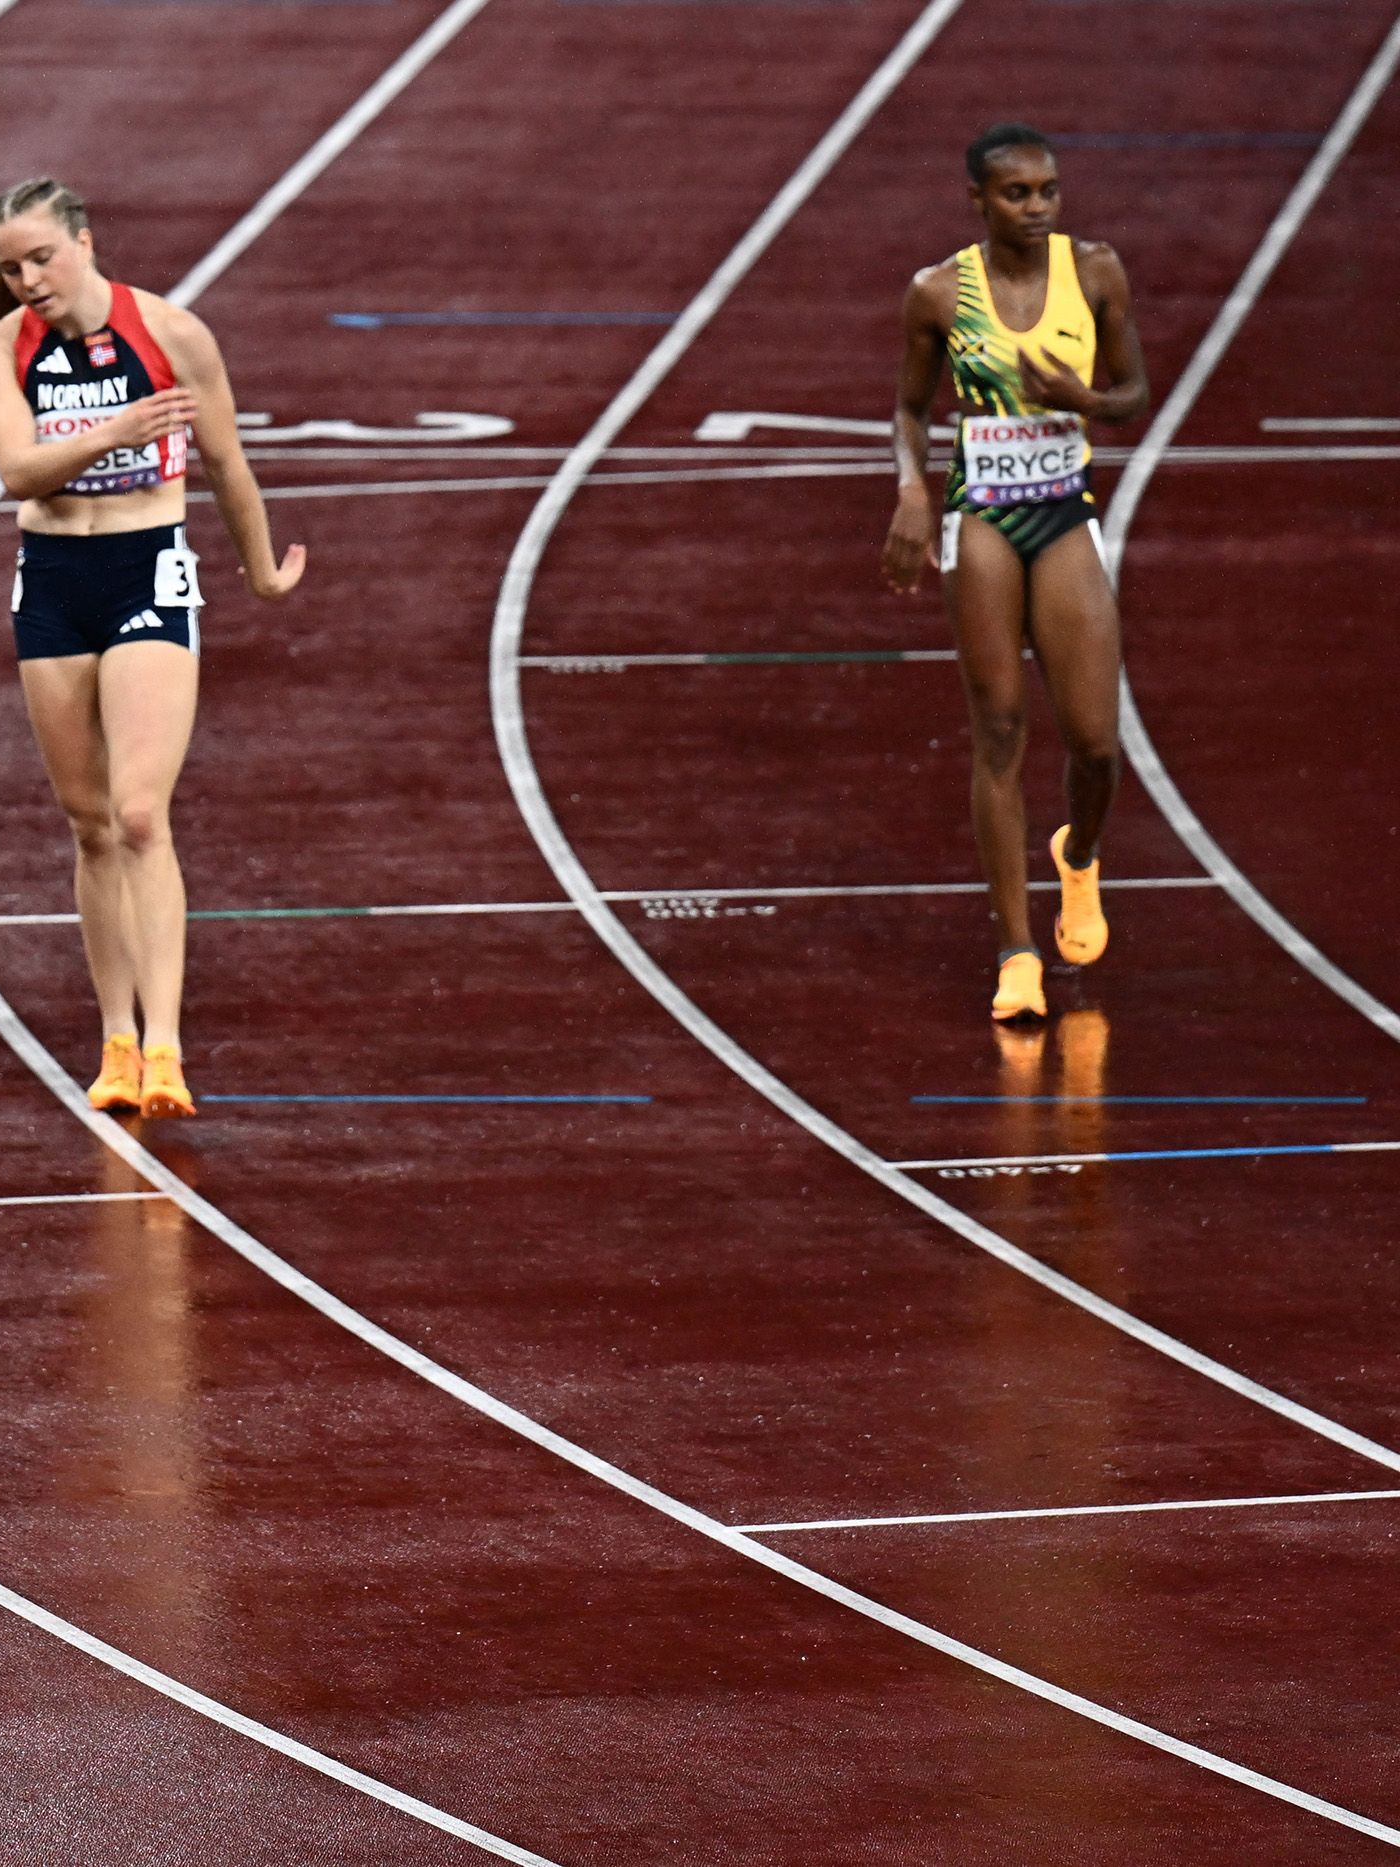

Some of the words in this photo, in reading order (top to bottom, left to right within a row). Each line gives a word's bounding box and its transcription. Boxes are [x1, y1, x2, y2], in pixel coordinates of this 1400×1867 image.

[37, 375, 128, 410] NORWAY
[976, 445, 1077, 478] PRYCE
[175, 560, 190, 597] 3
